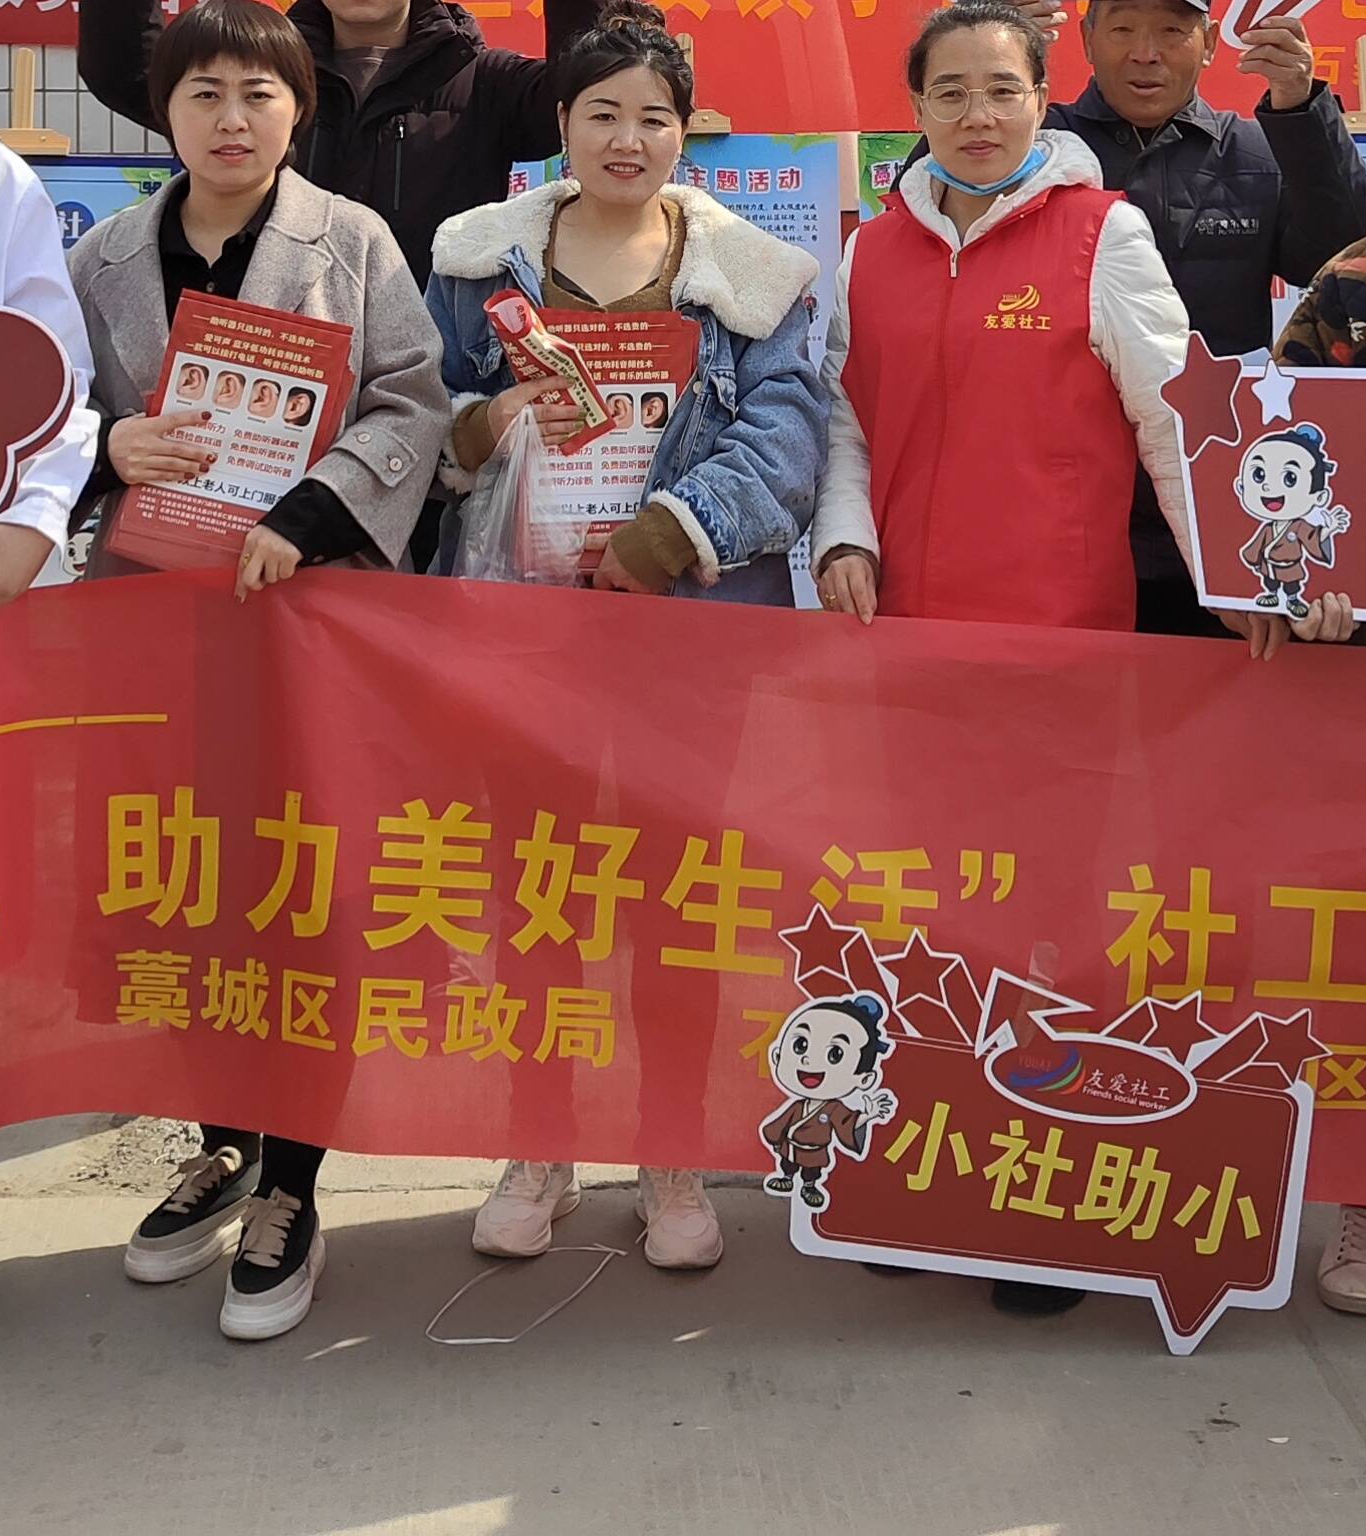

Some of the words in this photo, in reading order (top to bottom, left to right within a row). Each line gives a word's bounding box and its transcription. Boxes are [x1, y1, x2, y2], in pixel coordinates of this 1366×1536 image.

[982, 313, 1052, 331] 友爱社工
[115, 949, 617, 1070] 藁城区民政局
[1082, 1085, 1113, 1101] Friends
[1113, 1093, 1138, 1106] social
[1138, 1098, 1168, 1112] worker
[1085, 1068, 1171, 1101] 友爱社工
[883, 1101, 1262, 1256] 小社助小
